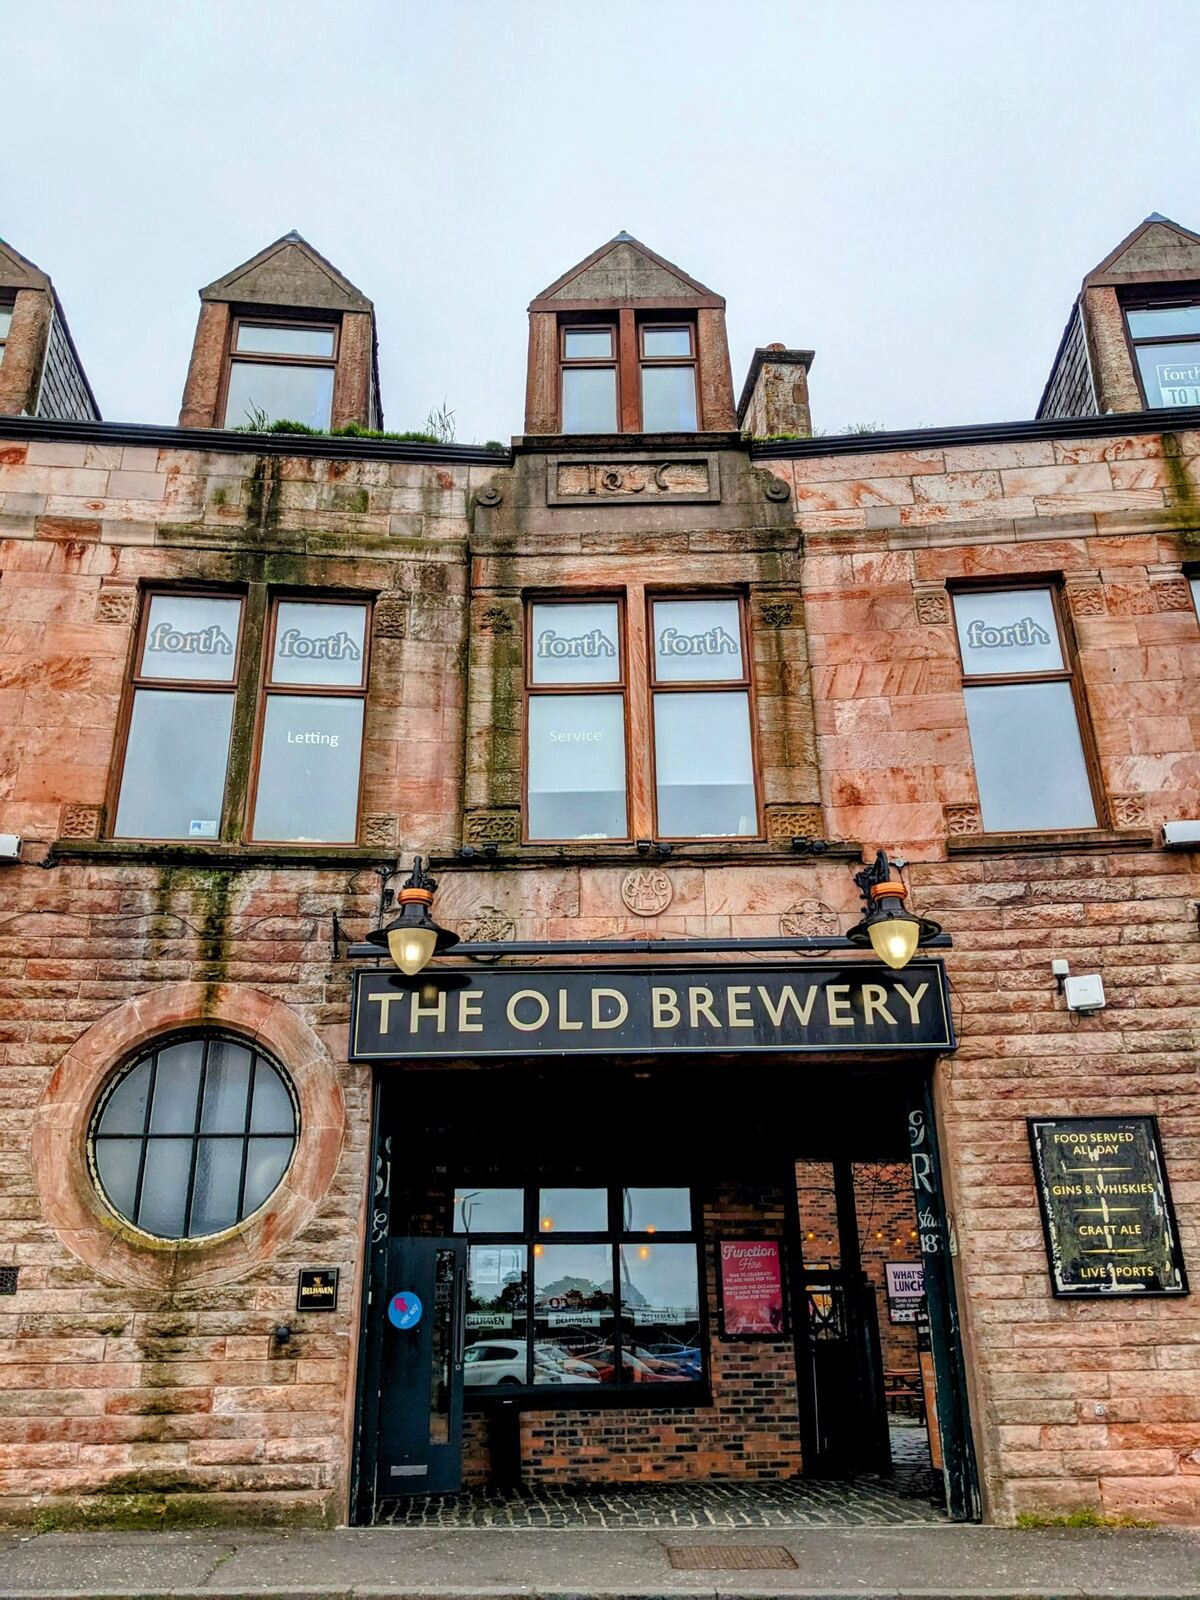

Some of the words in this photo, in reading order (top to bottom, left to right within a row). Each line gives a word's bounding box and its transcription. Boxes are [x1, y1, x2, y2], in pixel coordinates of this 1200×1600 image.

[1168, 388, 1188, 405] TO
[151, 623, 233, 654] forth
[967, 617, 1050, 648] forth
[279, 629, 360, 660] forth
[537, 630, 616, 658] forth
[660, 627, 738, 656] forth
[287, 731, 340, 747] Letting
[549, 730, 602, 742] Service
[368, 990, 484, 1034] THE
[506, 988, 629, 1031] OLD
[651, 983, 929, 1028] BREWERY
[1054, 1133, 1088, 1144] FOOD
[1090, 1133, 1134, 1143] SERVED
[1073, 1145, 1094, 1155] ALL
[1096, 1145, 1119, 1154] DAY
[1052, 1185, 1082, 1196] GINS
[1084, 1185, 1094, 1194] &
[1096, 1184, 1154, 1195] WHISKIES
[1120, 1225, 1142, 1235] ALE
[723, 1244, 776, 1259] Function
[738, 1258, 762, 1270] Hire
[893, 1270, 924, 1280] WHAT'S
[1080, 1267, 1106, 1278] LIVE
[302, 1286, 334, 1296] BELHAVEN
[894, 1280, 926, 1292] LUNCH
[466, 1316, 505, 1326] BELHAVEN
